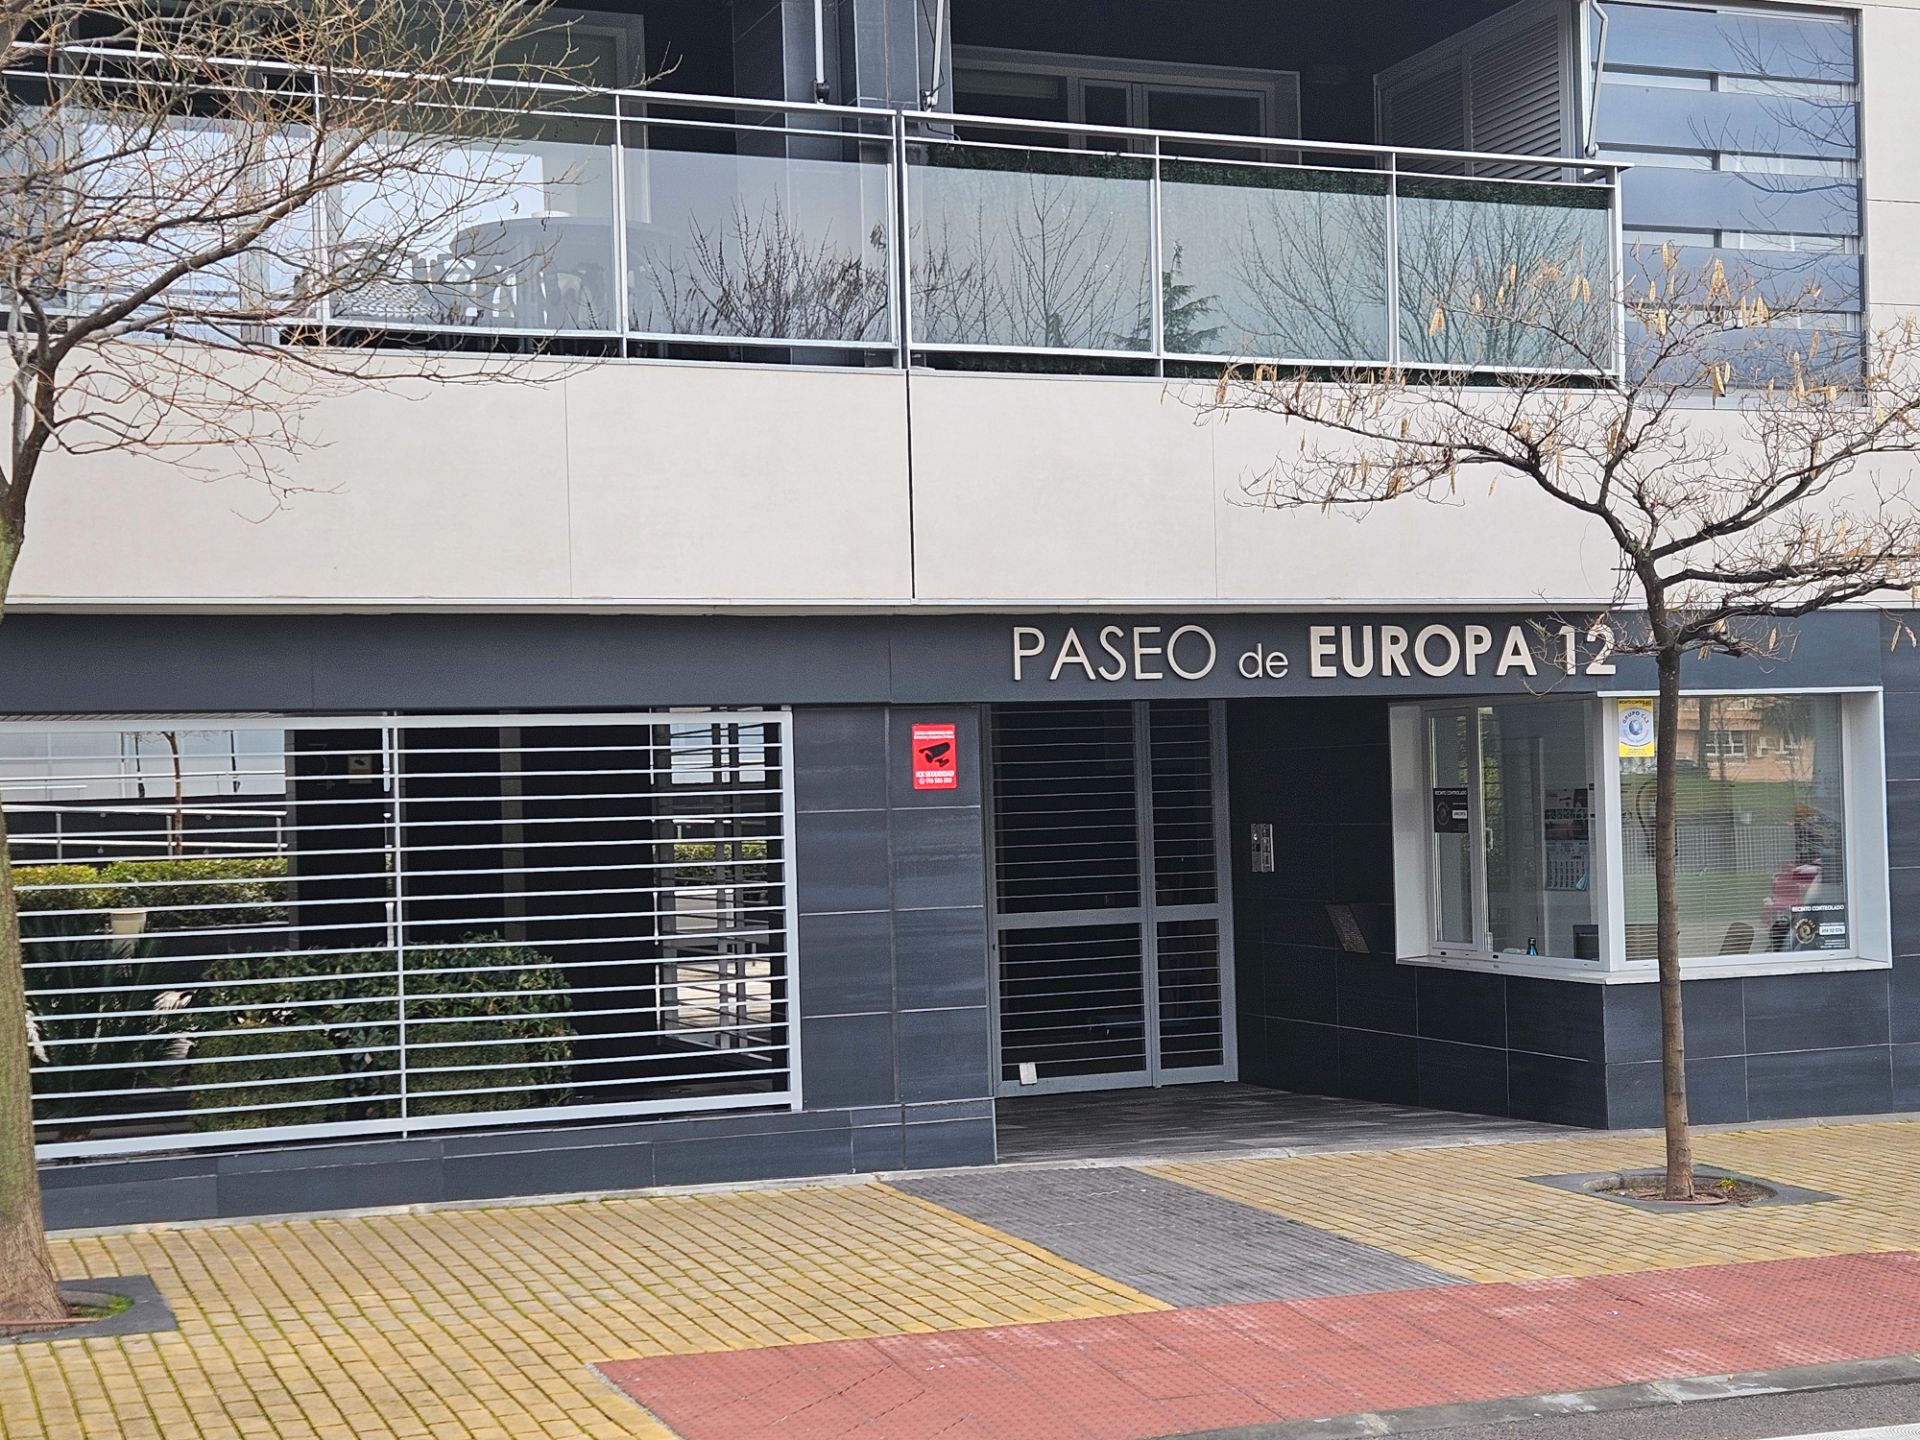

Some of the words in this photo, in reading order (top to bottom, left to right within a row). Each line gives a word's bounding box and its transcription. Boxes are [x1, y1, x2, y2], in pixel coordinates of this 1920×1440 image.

[1012, 624, 1217, 681] PASEO
[1238, 642, 1289, 679] de
[1309, 624, 1538, 678] EUROPA
[1558, 623, 1617, 676] 12
